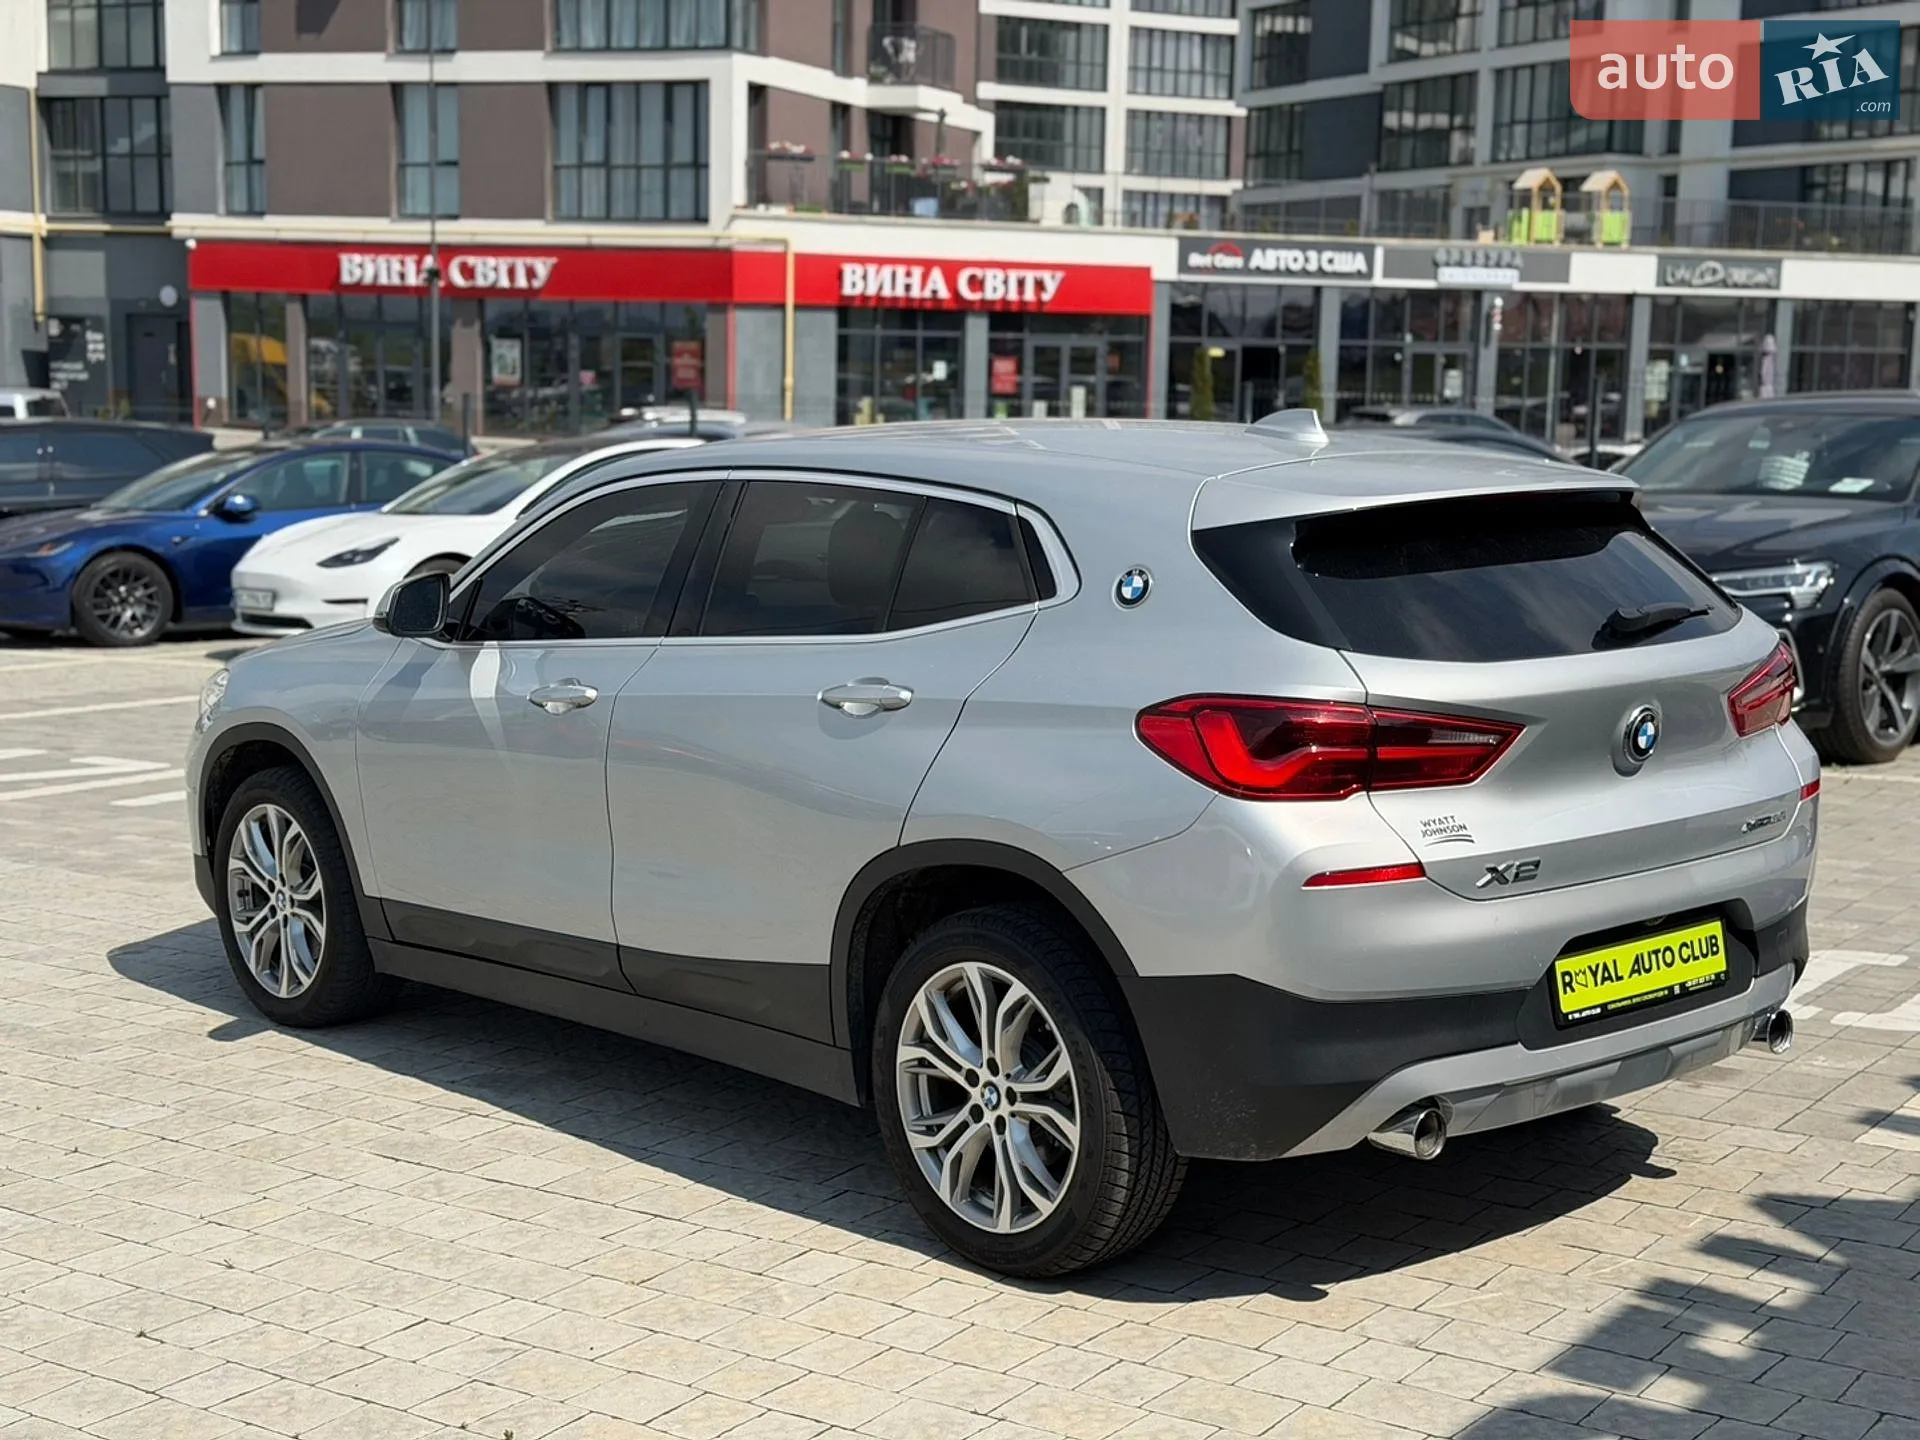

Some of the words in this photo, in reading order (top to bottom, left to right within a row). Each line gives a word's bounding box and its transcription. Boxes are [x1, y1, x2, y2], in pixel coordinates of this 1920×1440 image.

[338, 253, 445, 287] ВИНА
[448, 255, 558, 289] СВІТУ
[840, 263, 951, 299] ВИНА
[957, 267, 1065, 302] СВІТУ
[1420, 815, 1456, 828] WYATT
[1421, 823, 1468, 838] JOHNSON
[1476, 857, 1541, 888] X2
[1628, 946, 1675, 979] AUTO
[1678, 934, 1720, 964] CLUB
